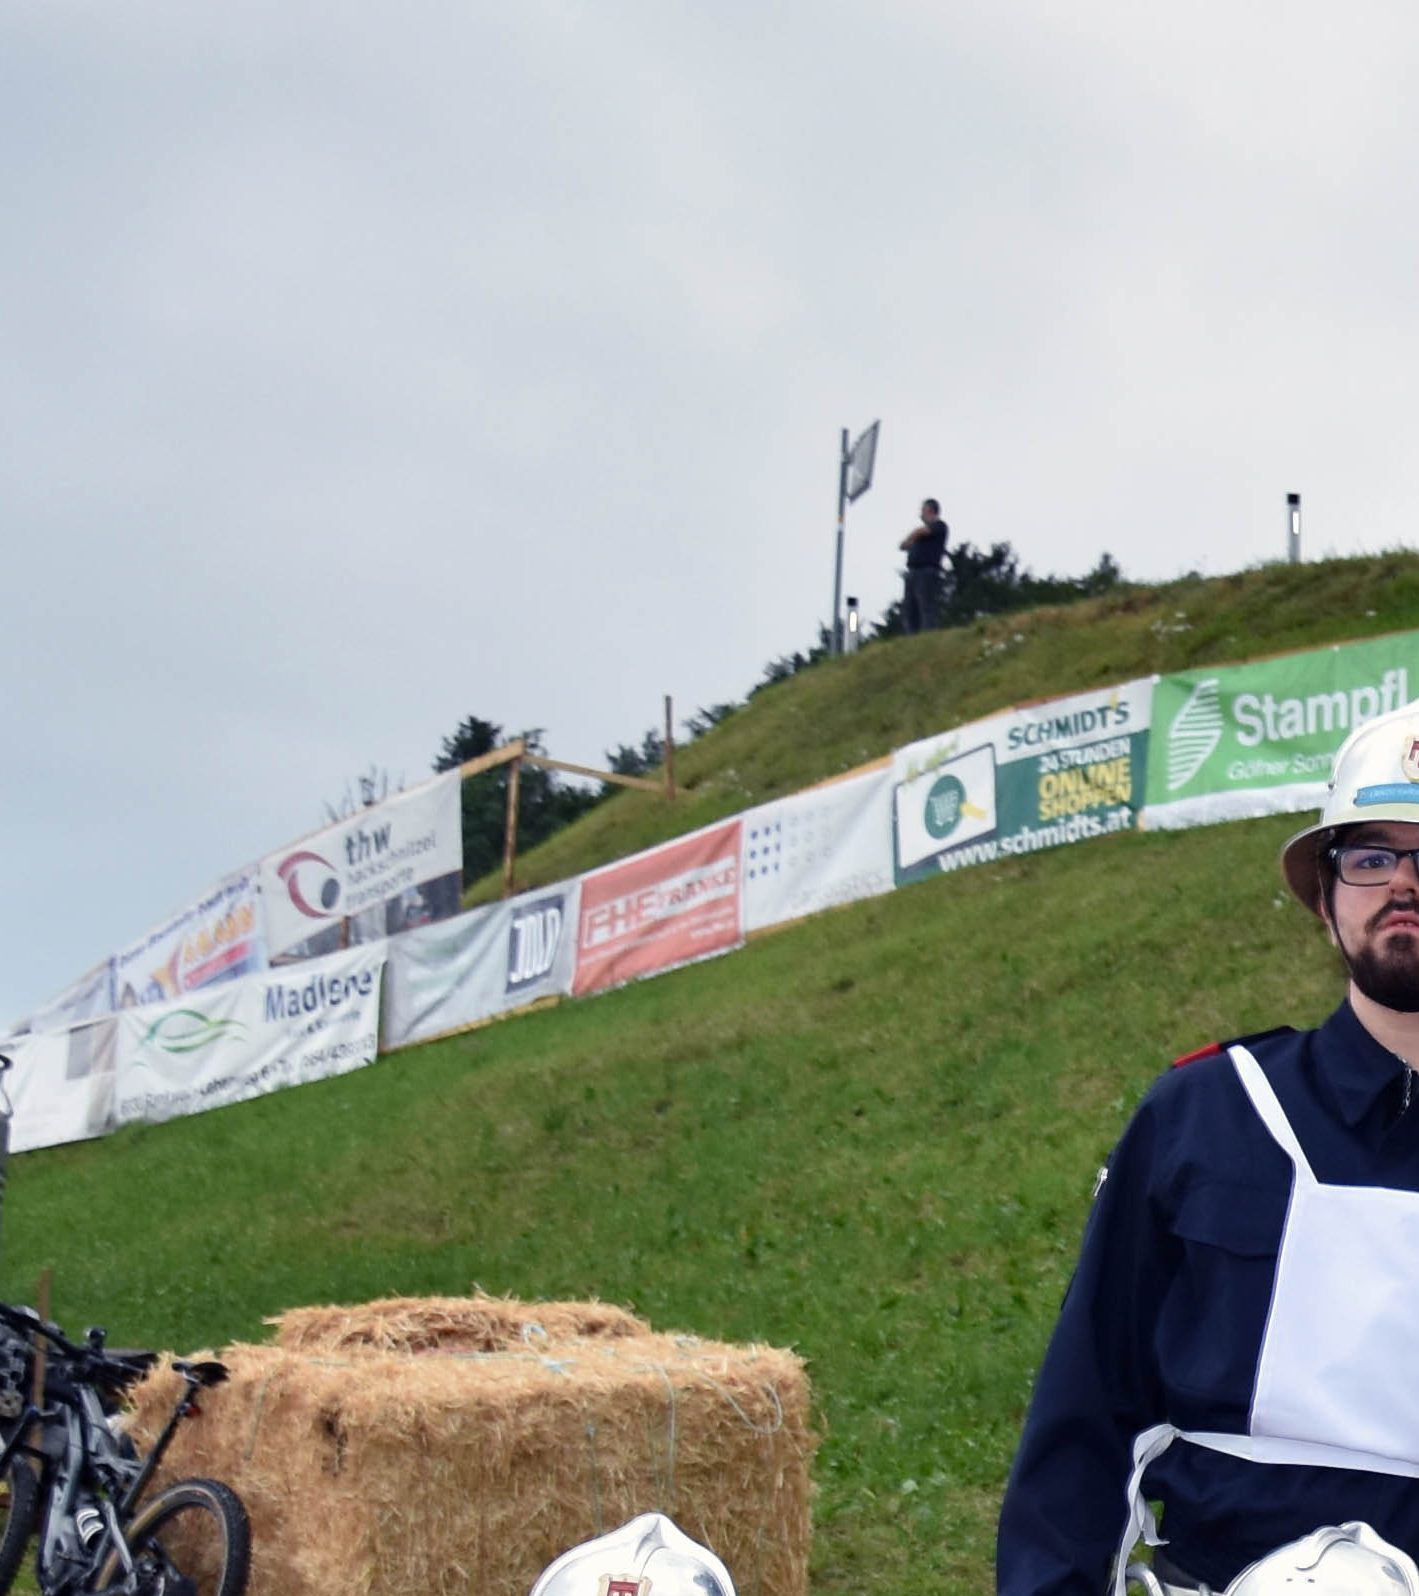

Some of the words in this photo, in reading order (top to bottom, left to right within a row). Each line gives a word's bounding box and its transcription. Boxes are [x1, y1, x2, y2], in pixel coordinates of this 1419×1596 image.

[1232, 668, 1408, 747] Stampfl
[1039, 759, 1132, 799] ONLINE
[1293, 753, 1333, 774] Sonn
[1038, 785, 1132, 821] SHOPPEN
[937, 808, 1133, 873] www.schmidts.at
